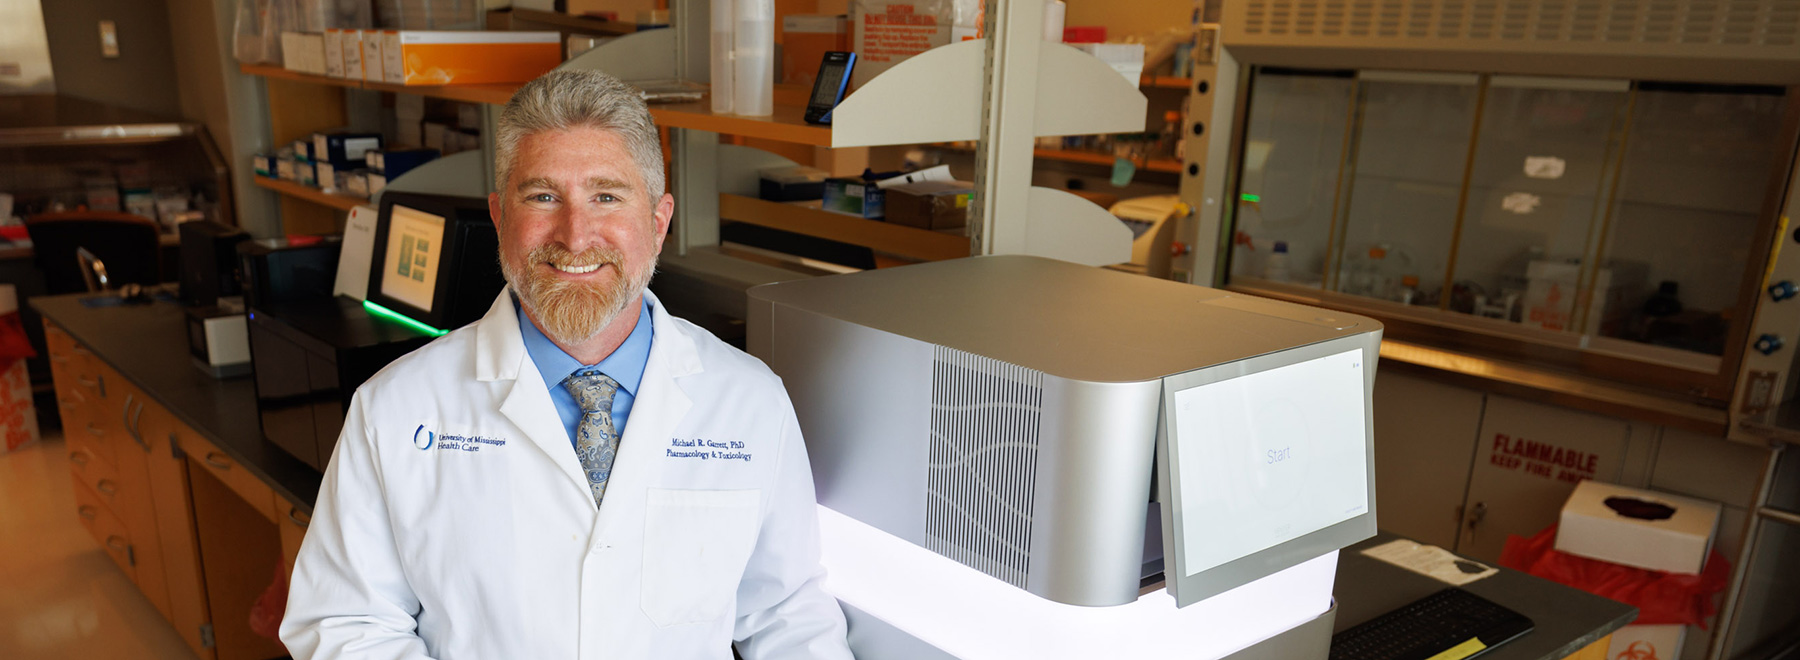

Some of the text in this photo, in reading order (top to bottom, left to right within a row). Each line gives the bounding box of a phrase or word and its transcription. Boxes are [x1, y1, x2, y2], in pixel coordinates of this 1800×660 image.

[886, 4, 914, 14] CAUTION
[439, 433, 466, 443] University
[474, 436, 505, 446] Mississippi
[672, 438, 695, 447] Michael
[697, 439, 705, 447] R.
[462, 443, 479, 451] Care
[666, 449, 709, 460] Pharmacology
[718, 452, 752, 461] Toxicology
[1267, 446, 1291, 464] Start
[1493, 433, 1599, 474] FLAMMABLE
[1490, 453, 1522, 470] KEEP
[1525, 461, 1553, 478] FIRE
